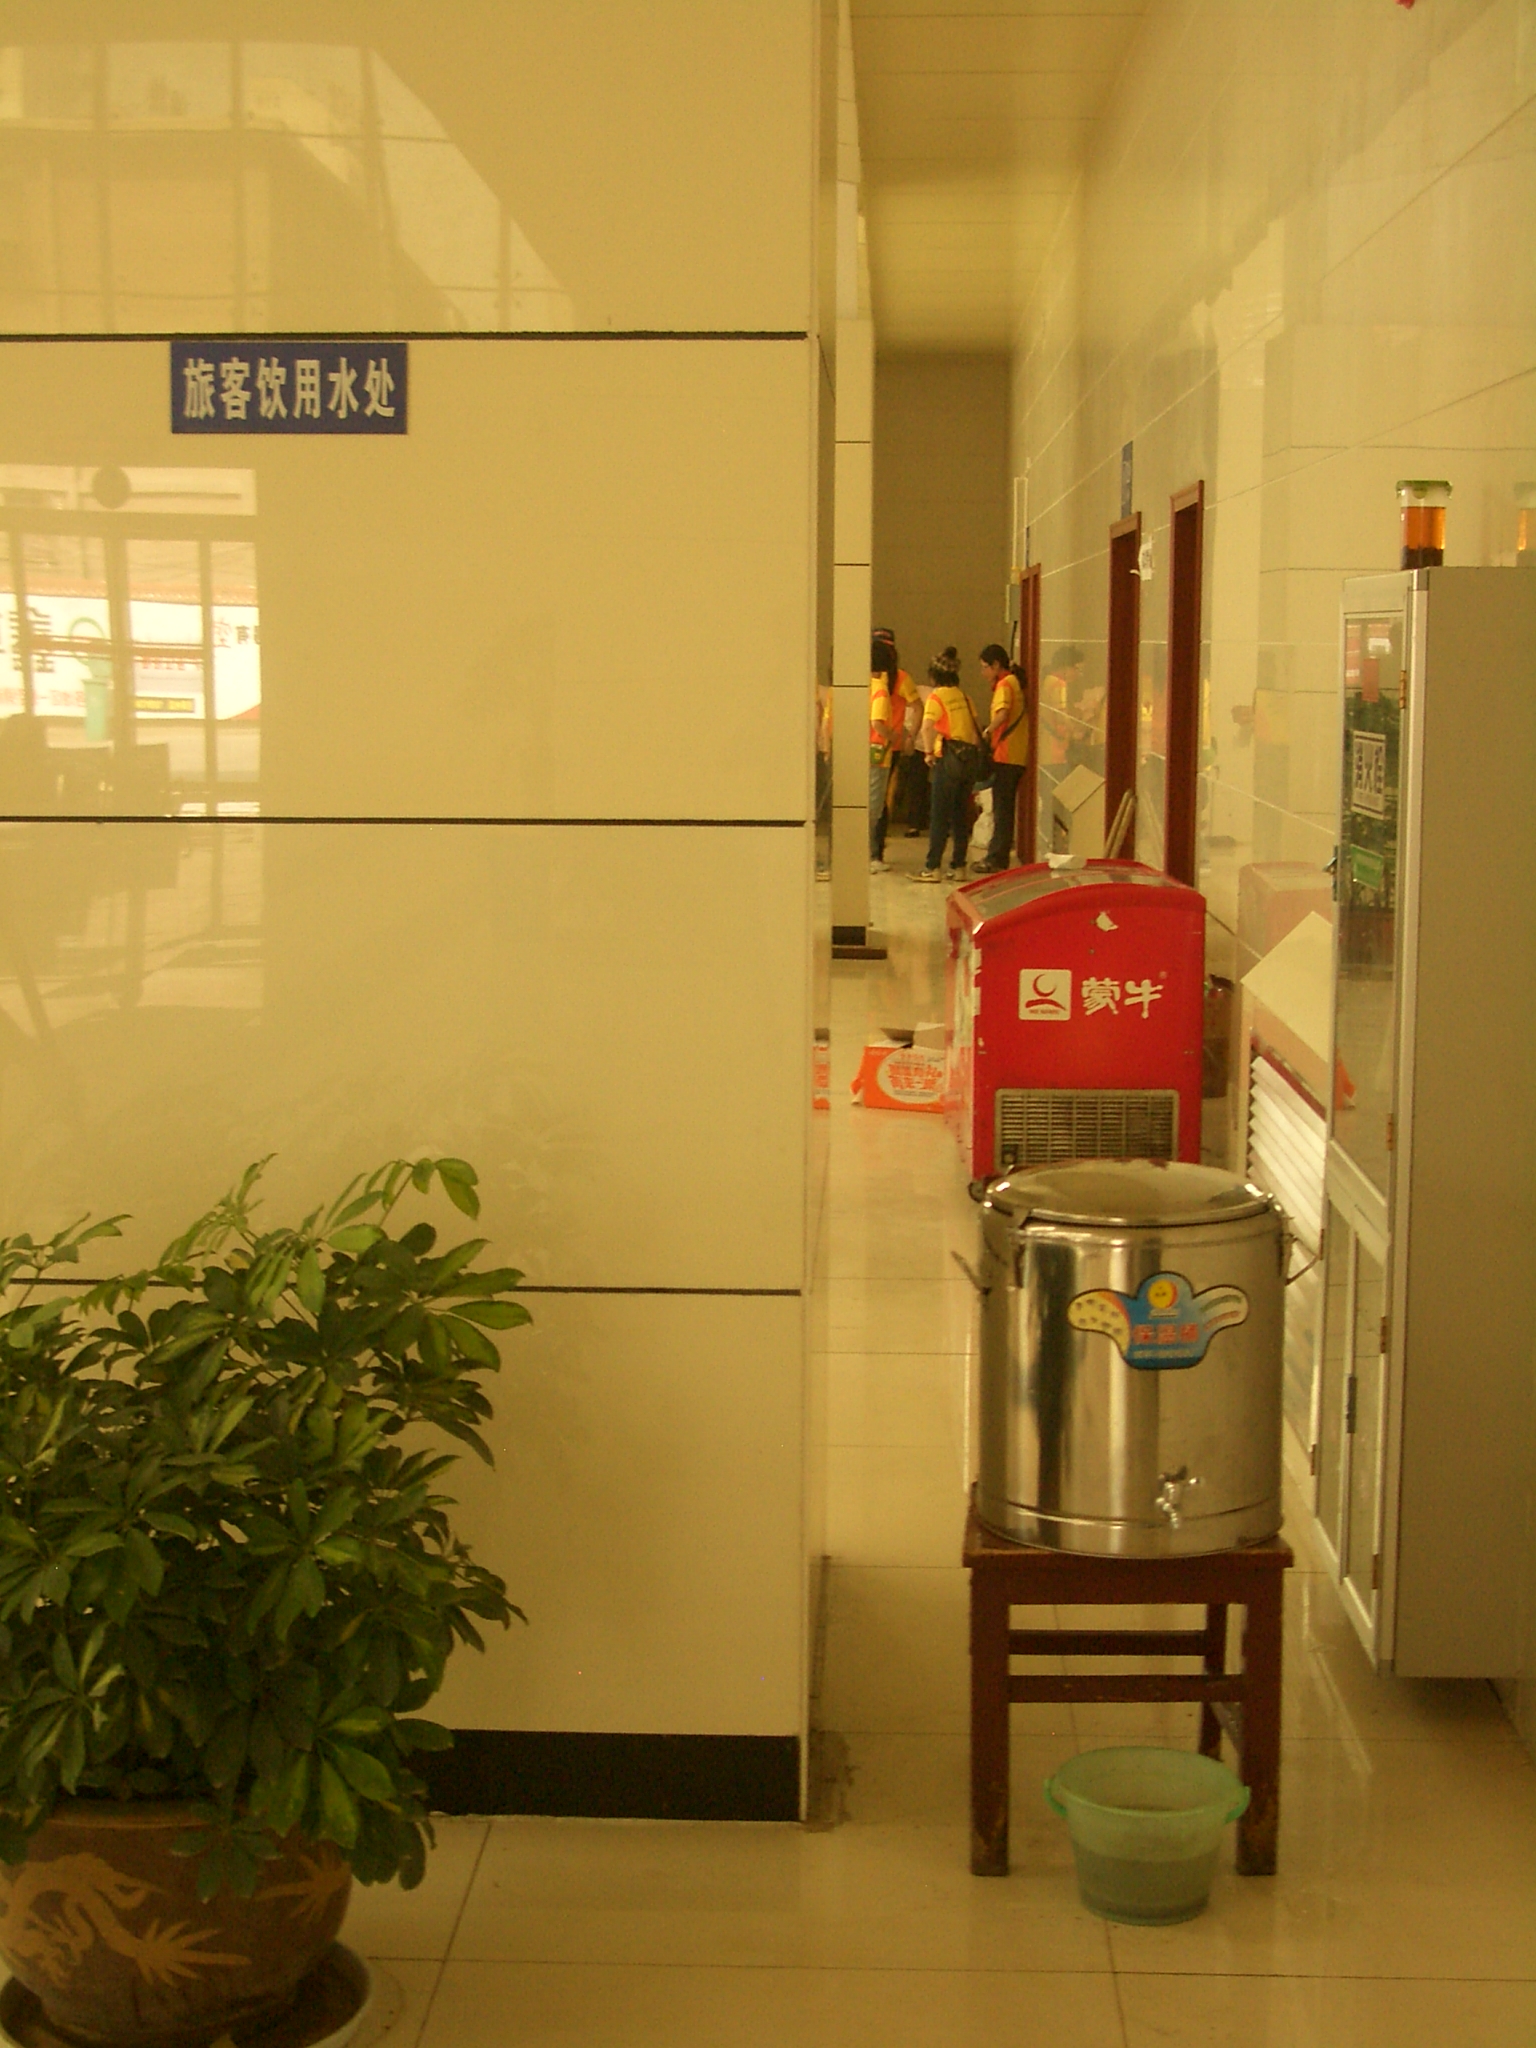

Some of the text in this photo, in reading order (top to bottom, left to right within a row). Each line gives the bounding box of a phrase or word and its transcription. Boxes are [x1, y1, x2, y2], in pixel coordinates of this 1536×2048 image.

[182, 356, 396, 420] 旅客饮用水处
[1080, 976, 1164, 1019] 蒙牛
